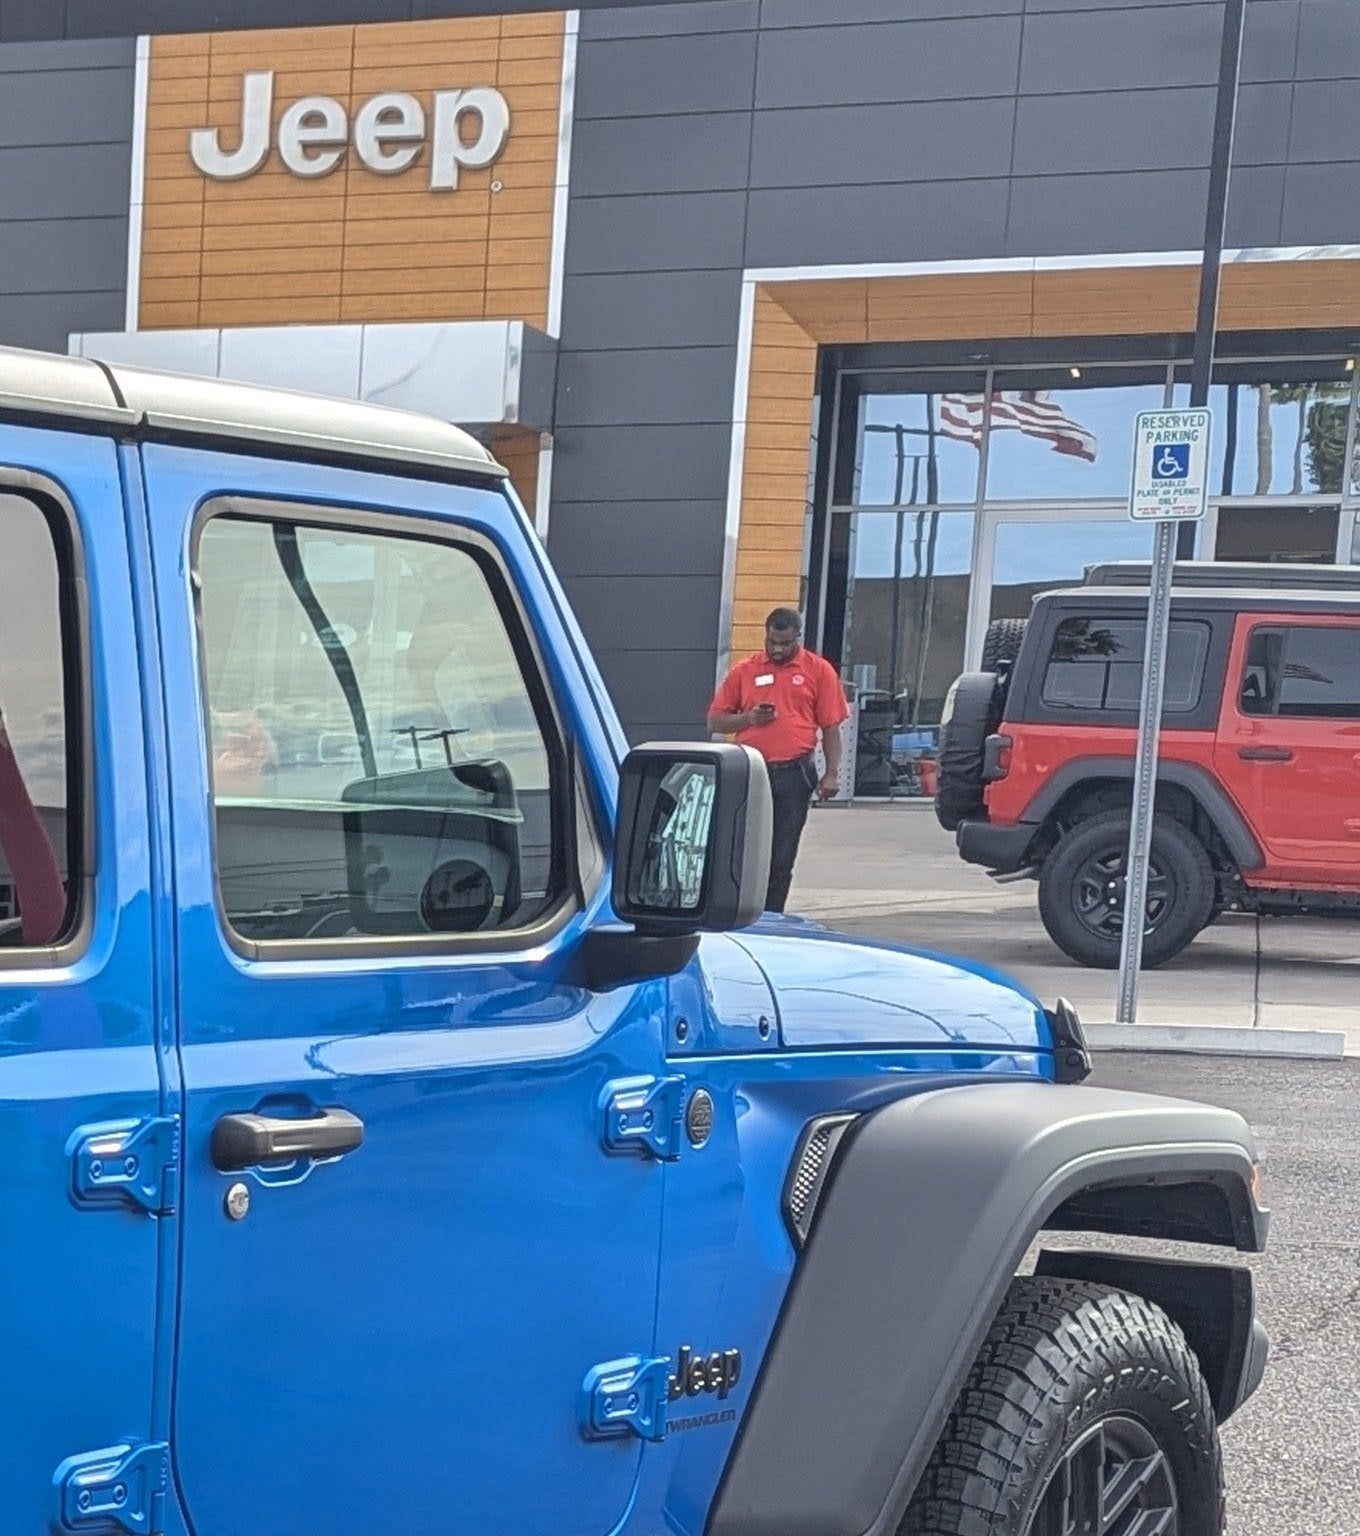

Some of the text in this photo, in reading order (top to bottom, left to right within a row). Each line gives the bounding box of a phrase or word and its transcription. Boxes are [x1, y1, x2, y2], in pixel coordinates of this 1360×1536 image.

[189, 69, 511, 192] Jeep
[1141, 415, 1205, 429] RESERVED
[1146, 430, 1199, 443] PARKING
[667, 1345, 742, 1401] Jeep
[667, 1409, 736, 1434] WRANGLER
